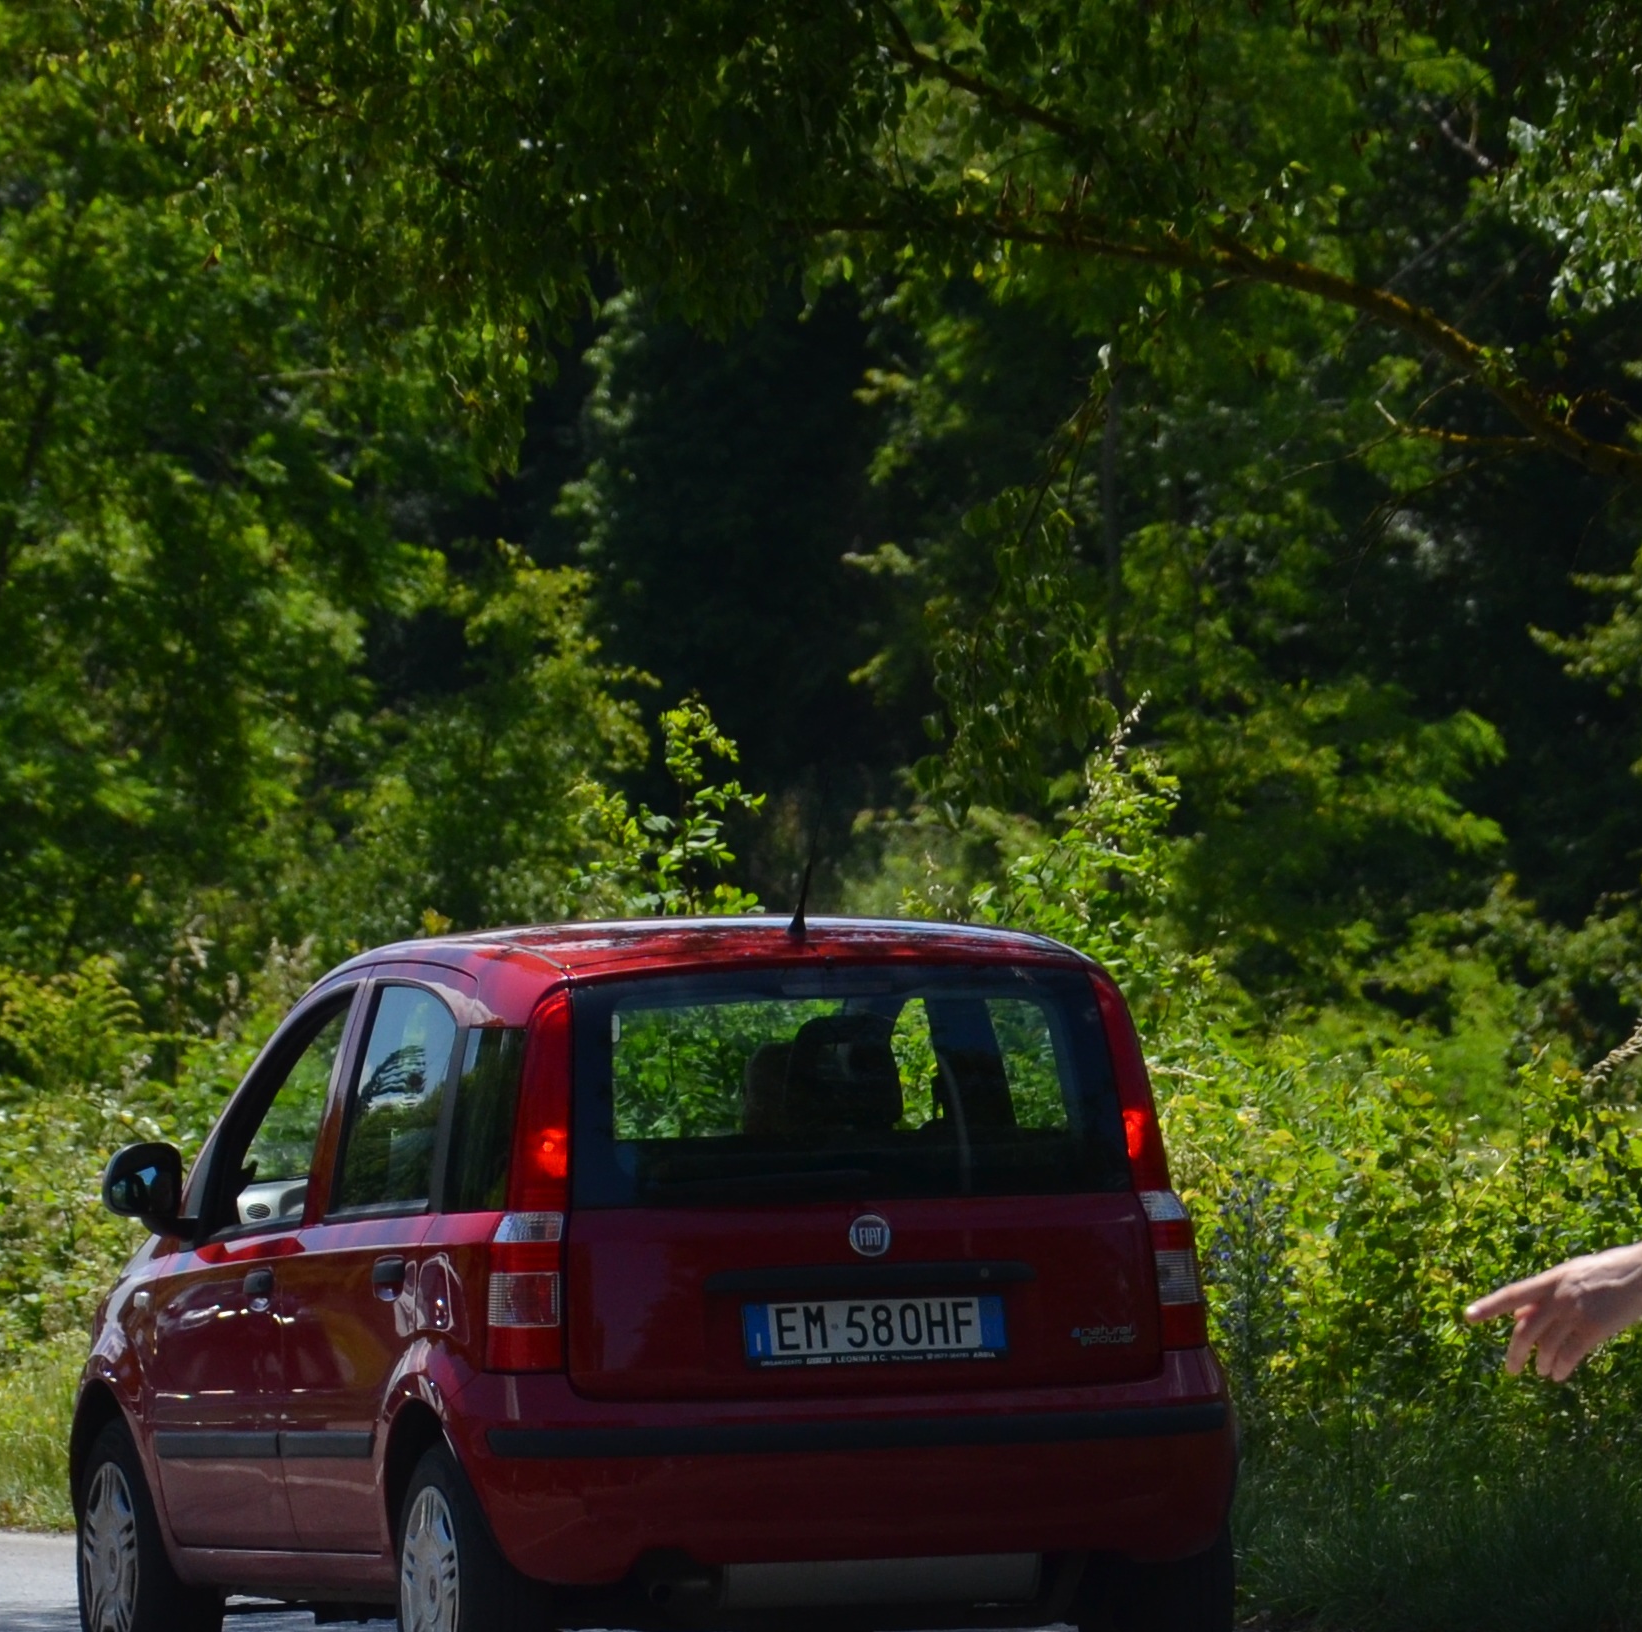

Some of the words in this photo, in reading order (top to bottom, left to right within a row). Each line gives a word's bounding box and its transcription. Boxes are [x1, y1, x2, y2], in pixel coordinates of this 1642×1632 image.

[858, 1227, 882, 1246] FIAT
[775, 1305, 828, 1350] EM
[846, 1301, 973, 1348] 580HF
[1082, 1323, 1132, 1336] natural
[1089, 1334, 1137, 1346] power
